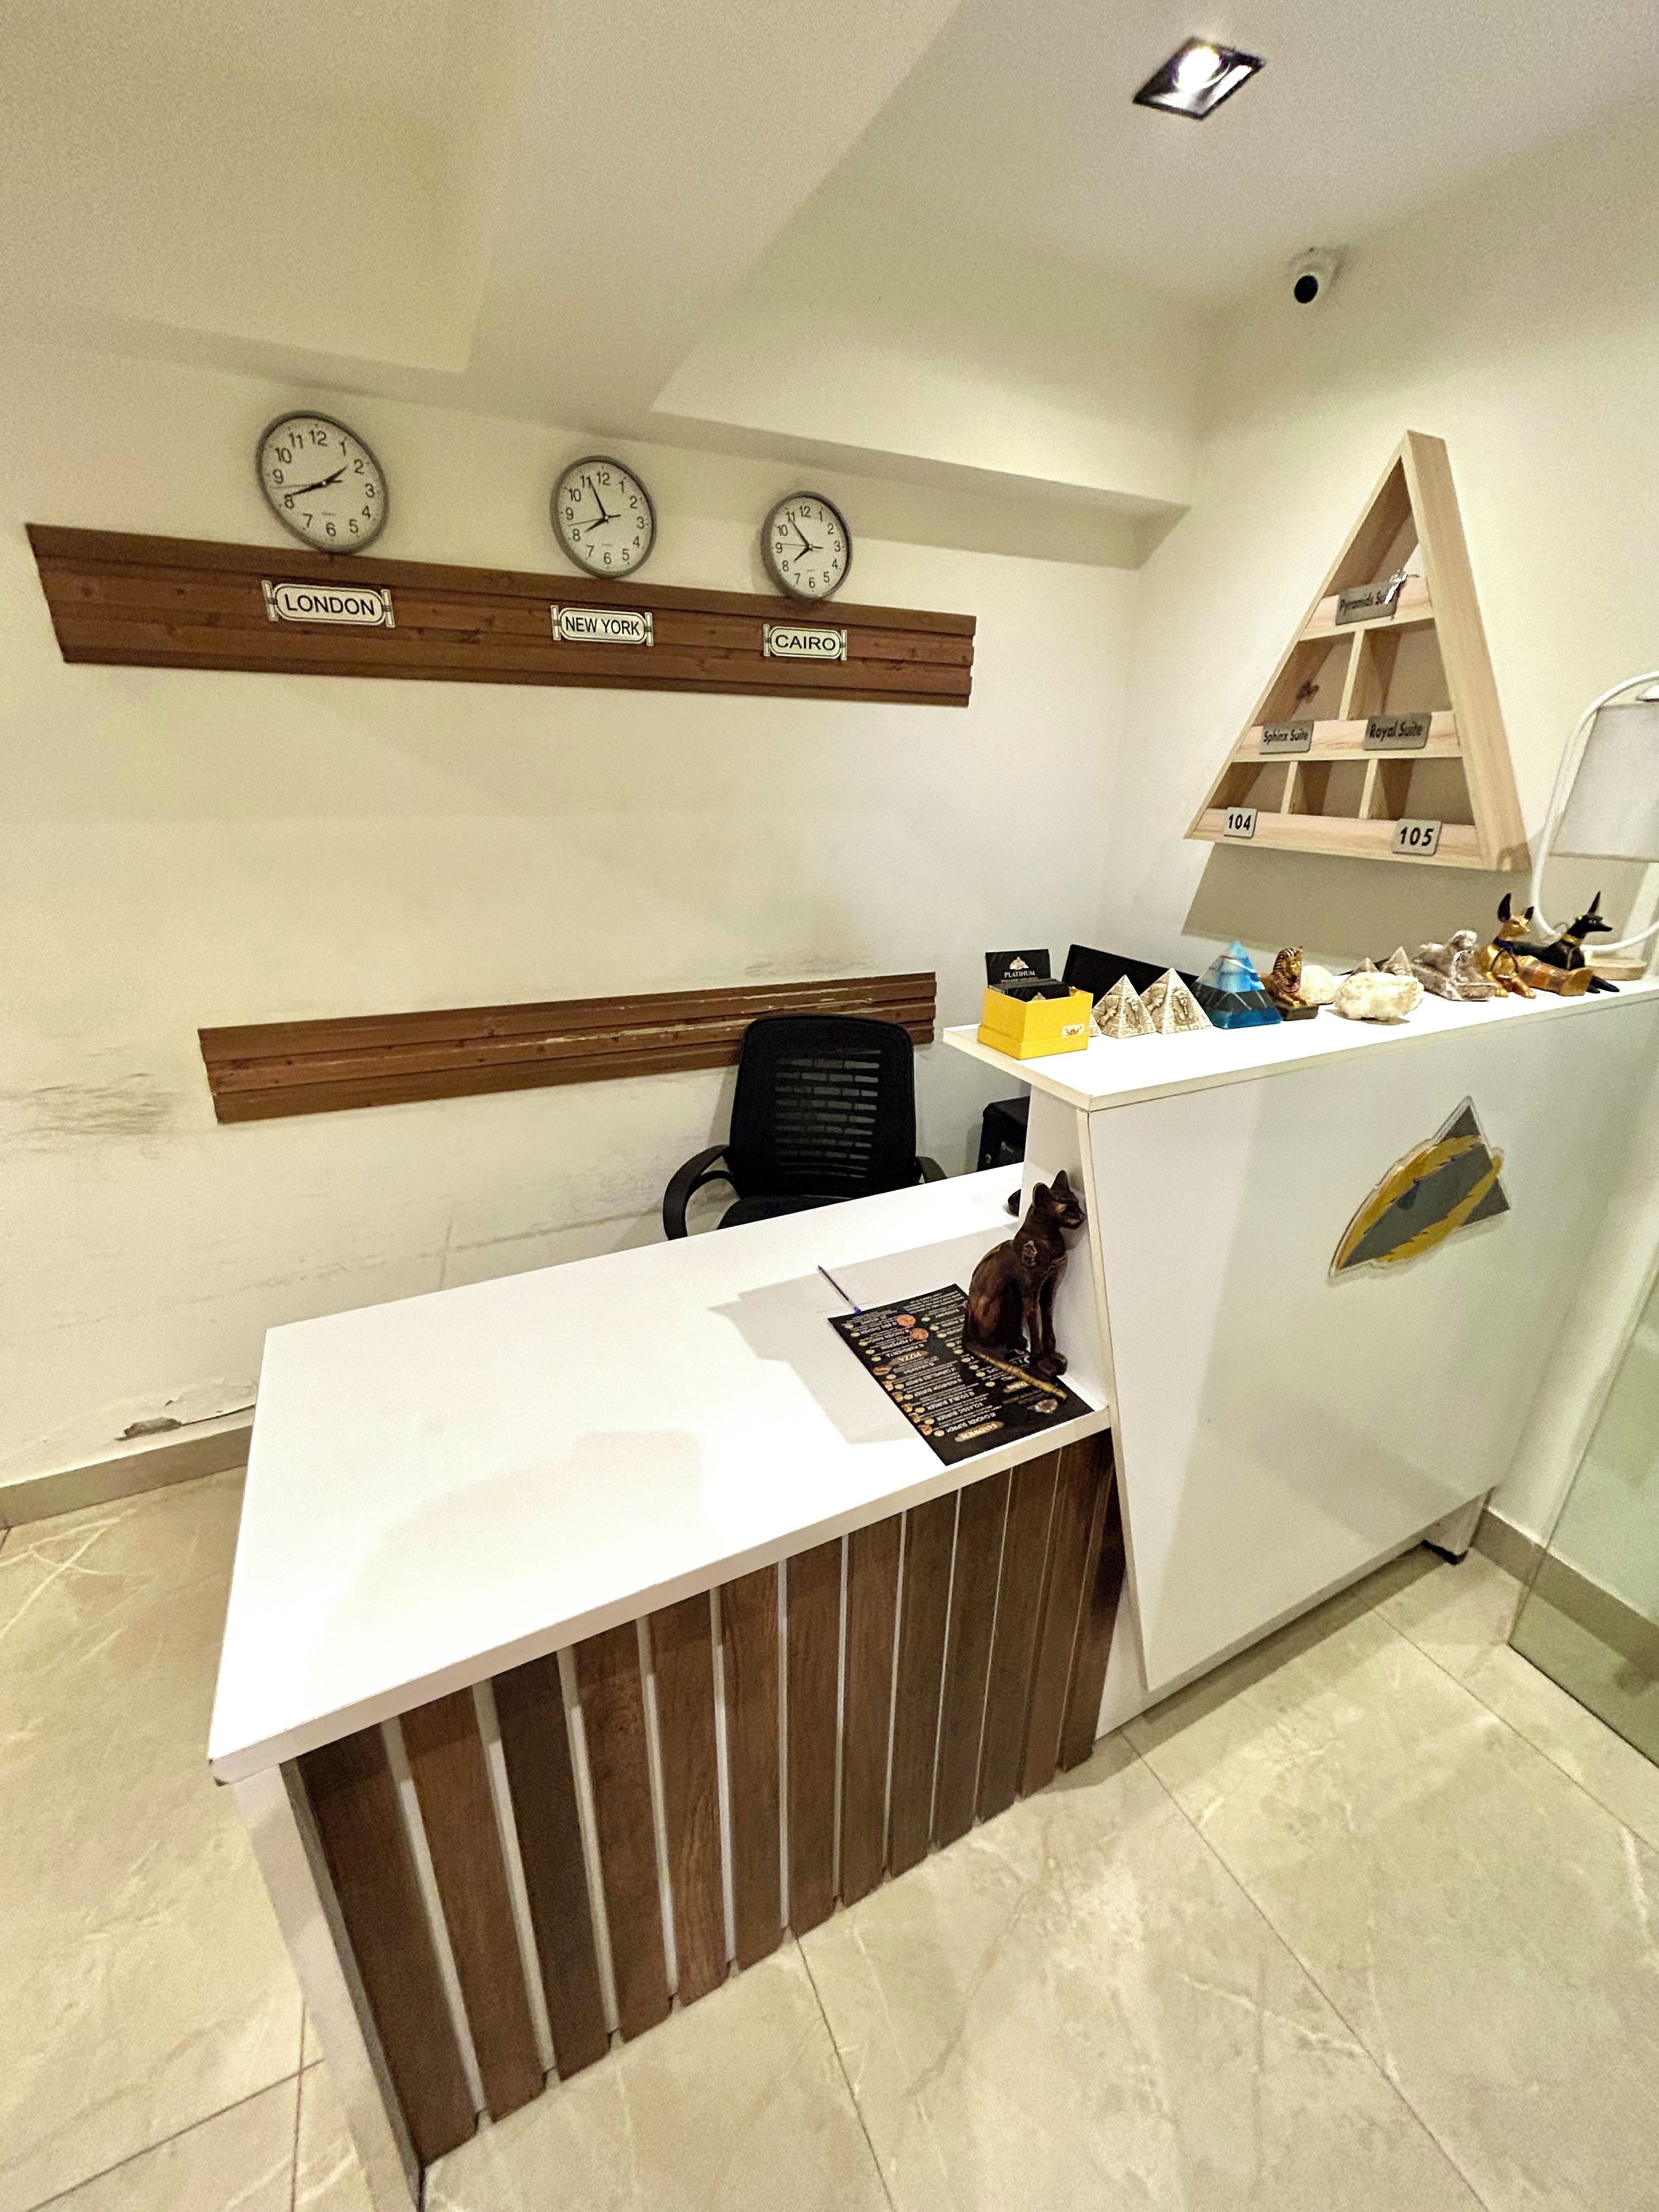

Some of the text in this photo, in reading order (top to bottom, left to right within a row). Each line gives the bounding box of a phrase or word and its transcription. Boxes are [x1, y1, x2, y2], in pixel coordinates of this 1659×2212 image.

[289, 433, 303, 449] 11
[309, 430, 327, 446] 12
[339, 441, 346, 455] 1
[275, 448, 291, 463] 10
[354, 459, 365, 474] 2
[273, 469, 284, 484] 9
[580, 475, 592, 488] 11
[597, 472, 611, 485] 12
[365, 483, 375, 498] 3
[619, 480, 624, 493] 1
[285, 494, 294, 509] 8
[568, 488, 581, 502] 10
[630, 495, 637, 509] 2
[362, 506, 370, 519] 4
[565, 507, 573, 520] 9
[786, 512, 795, 523] 11
[799, 506, 811, 517] 12
[819, 511, 823, 522] 1
[303, 513, 313, 528] 7
[349, 519, 358, 533] 5
[637, 517, 645, 529] 3
[326, 522, 336, 536] 6
[573, 529, 580, 541] 8
[777, 525, 787, 536] 10
[827, 523, 834, 535] 2
[633, 536, 639, 547] 4
[775, 542, 782, 553] 9
[834, 541, 840, 552] 3
[586, 545, 594, 557] 7
[622, 548, 629, 560] 5
[604, 552, 611, 565] 6
[832, 559, 838, 569] 4
[782, 560, 789, 571] 8
[794, 573, 801, 584] 7
[809, 577, 815, 588] 6
[824, 571, 830, 582] 5
[285, 594, 376, 616] LONDON
[566, 616, 640, 637] NEW YORK
[775, 634, 836, 652] CAIRO
[1263, 729, 1308, 745] Sphinx Suite
[1369, 721, 1423, 741] Royal Suite
[1228, 814, 1251, 831] 104
[1399, 827, 1434, 846] 105
[898, 1352, 921, 1362] PIZZA
[932, 1380, 957, 1390] MUSHROOM
[913, 1388, 933, 1396] BURGER
[948, 1393, 968, 1402] DOUBLE
[927, 1400, 948, 1410] BURGER
[936, 1411, 957, 1420] BURGER
[968, 1414, 990, 1424] CHICKEN
[961, 1423, 997, 1438] SANDWICH
